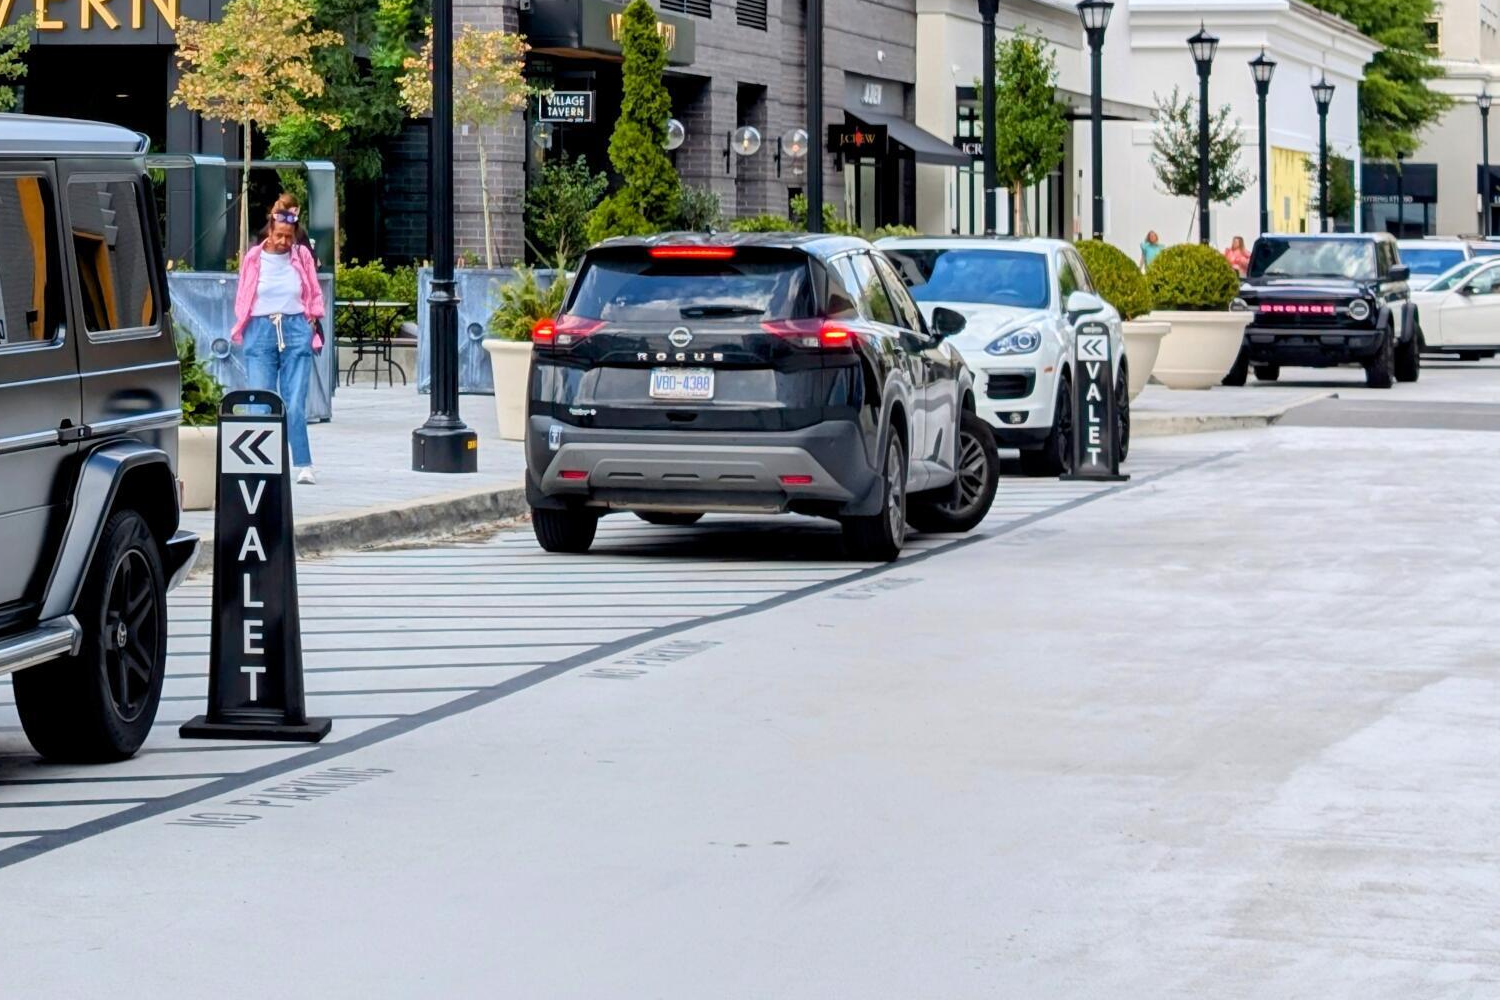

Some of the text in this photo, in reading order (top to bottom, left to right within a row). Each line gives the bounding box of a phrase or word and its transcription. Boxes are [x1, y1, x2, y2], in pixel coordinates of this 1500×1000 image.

[545, 95, 585, 106] VILLAGE
[547, 107, 585, 117] TAVERN
[636, 352, 724, 362] ROGUE
[1086, 361, 1102, 466] VALET
[237, 479, 267, 701] VALET
[164, 766, 395, 829] NO PARKING
